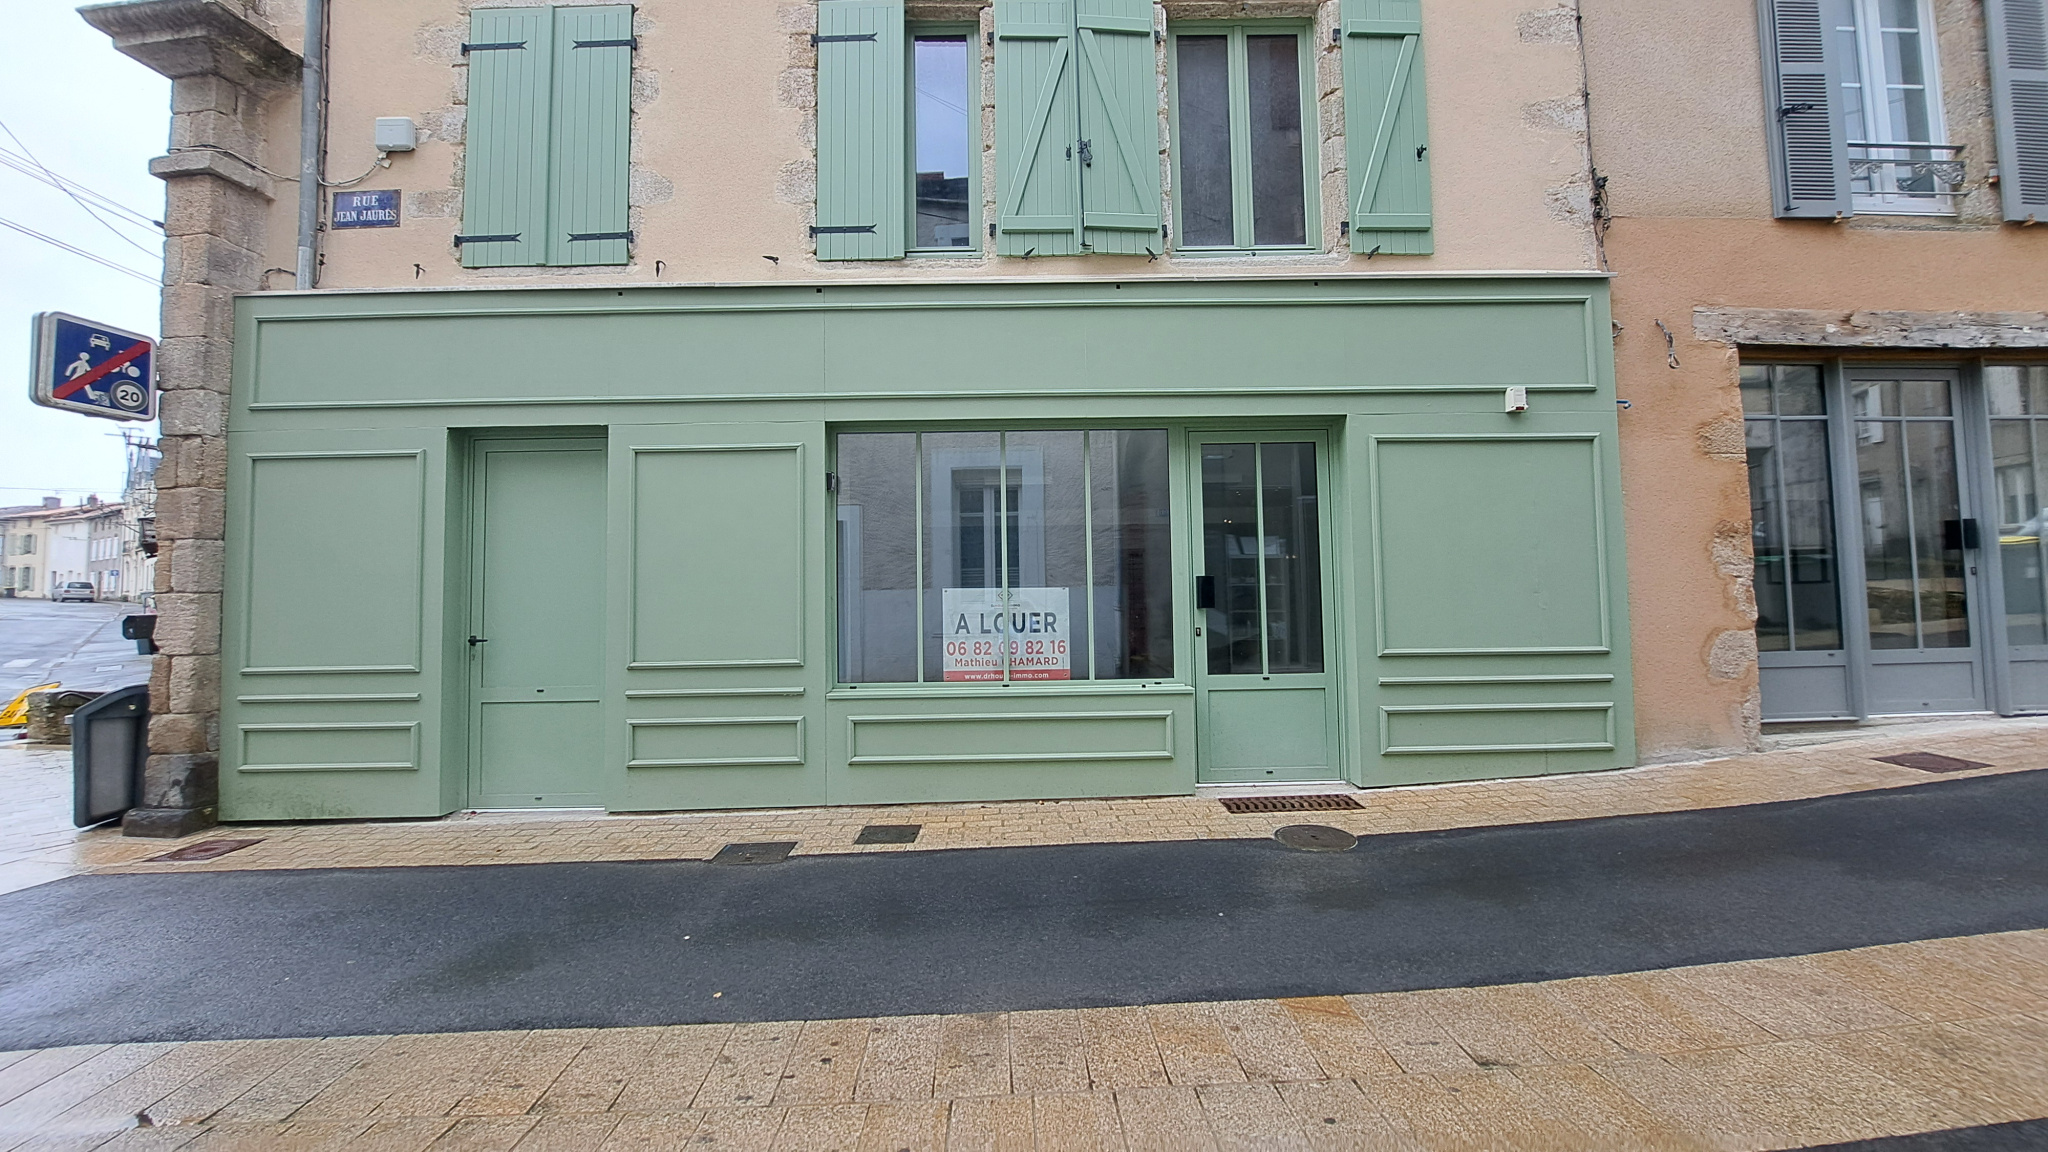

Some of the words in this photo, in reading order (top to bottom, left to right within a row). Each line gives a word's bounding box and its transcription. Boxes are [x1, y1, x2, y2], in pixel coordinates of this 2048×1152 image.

[353, 195, 379, 207] RUE
[334, 210, 358, 222] JEAN
[119, 390, 140, 402] 20
[955, 613, 971, 634] A
[980, 612, 1057, 634] LOUER
[947, 641, 967, 656] 06
[973, 641, 992, 656] 82
[998, 640, 1019, 656] 09
[1025, 640, 1044, 655] 82
[1050, 640, 1066, 654] 16
[954, 657, 998, 667] Mathieu
[1001, 656, 1059, 667] HAMARD
[964, 672, 1049, 680] www.drhou-immo.com
